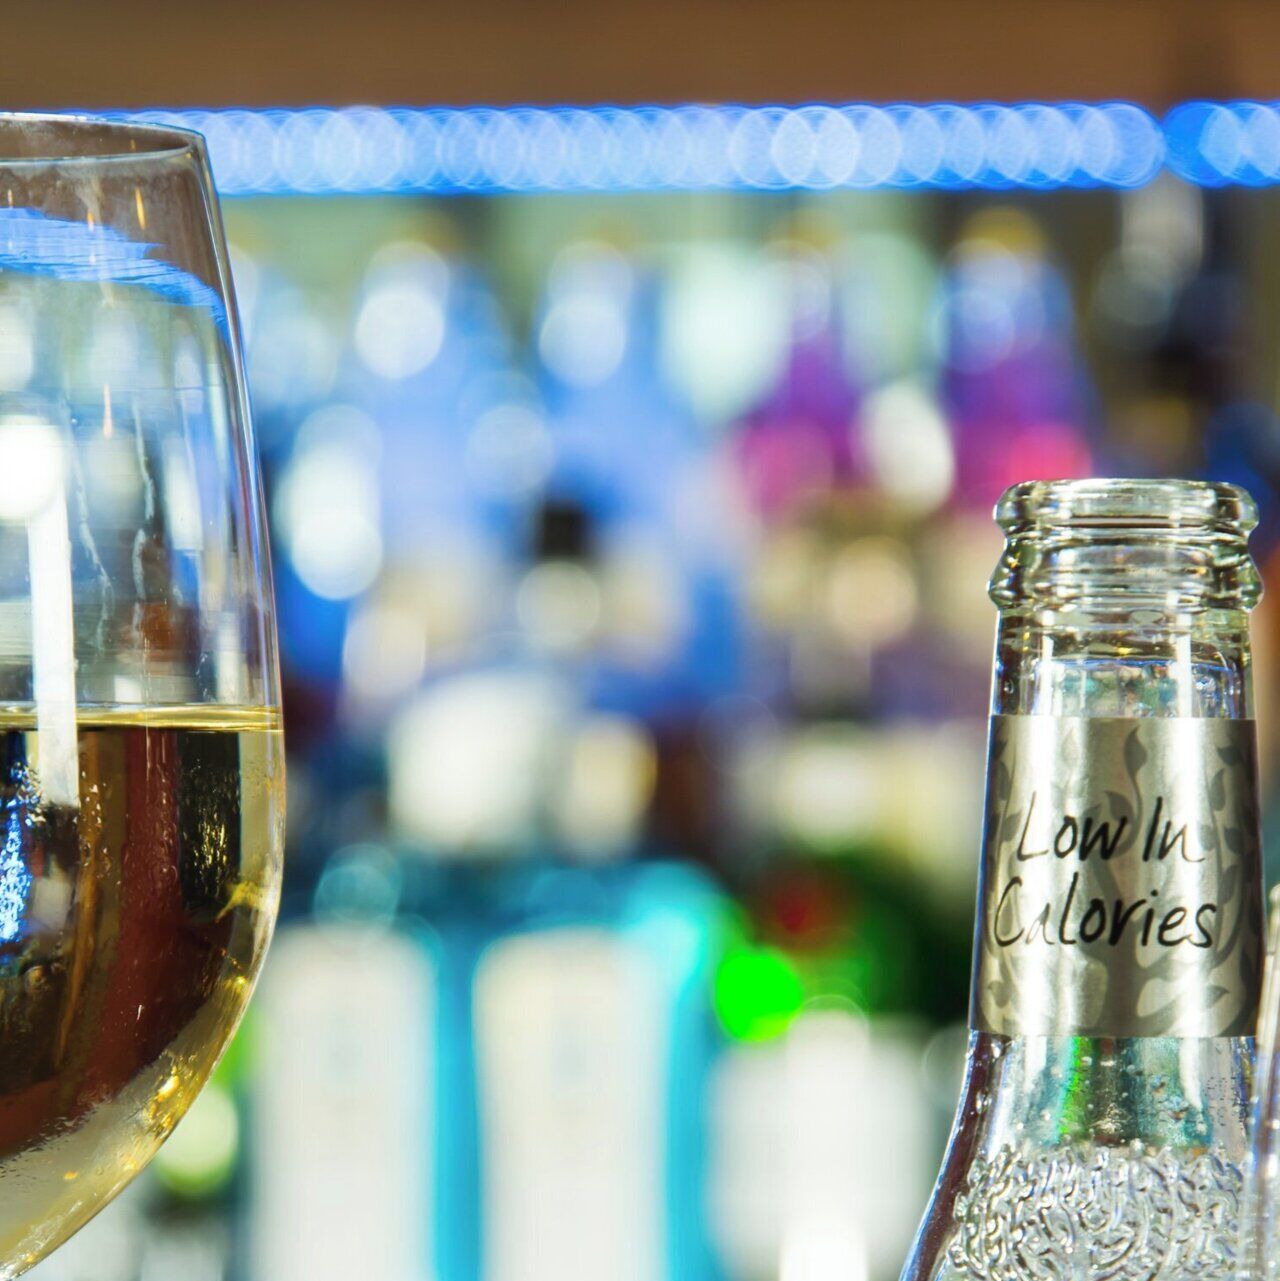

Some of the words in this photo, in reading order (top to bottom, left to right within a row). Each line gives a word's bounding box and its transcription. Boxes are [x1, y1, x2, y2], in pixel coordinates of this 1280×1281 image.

[1016, 790, 1128, 862] Low
[1142, 796, 1206, 862] In
[994, 872, 1218, 949] Calories
